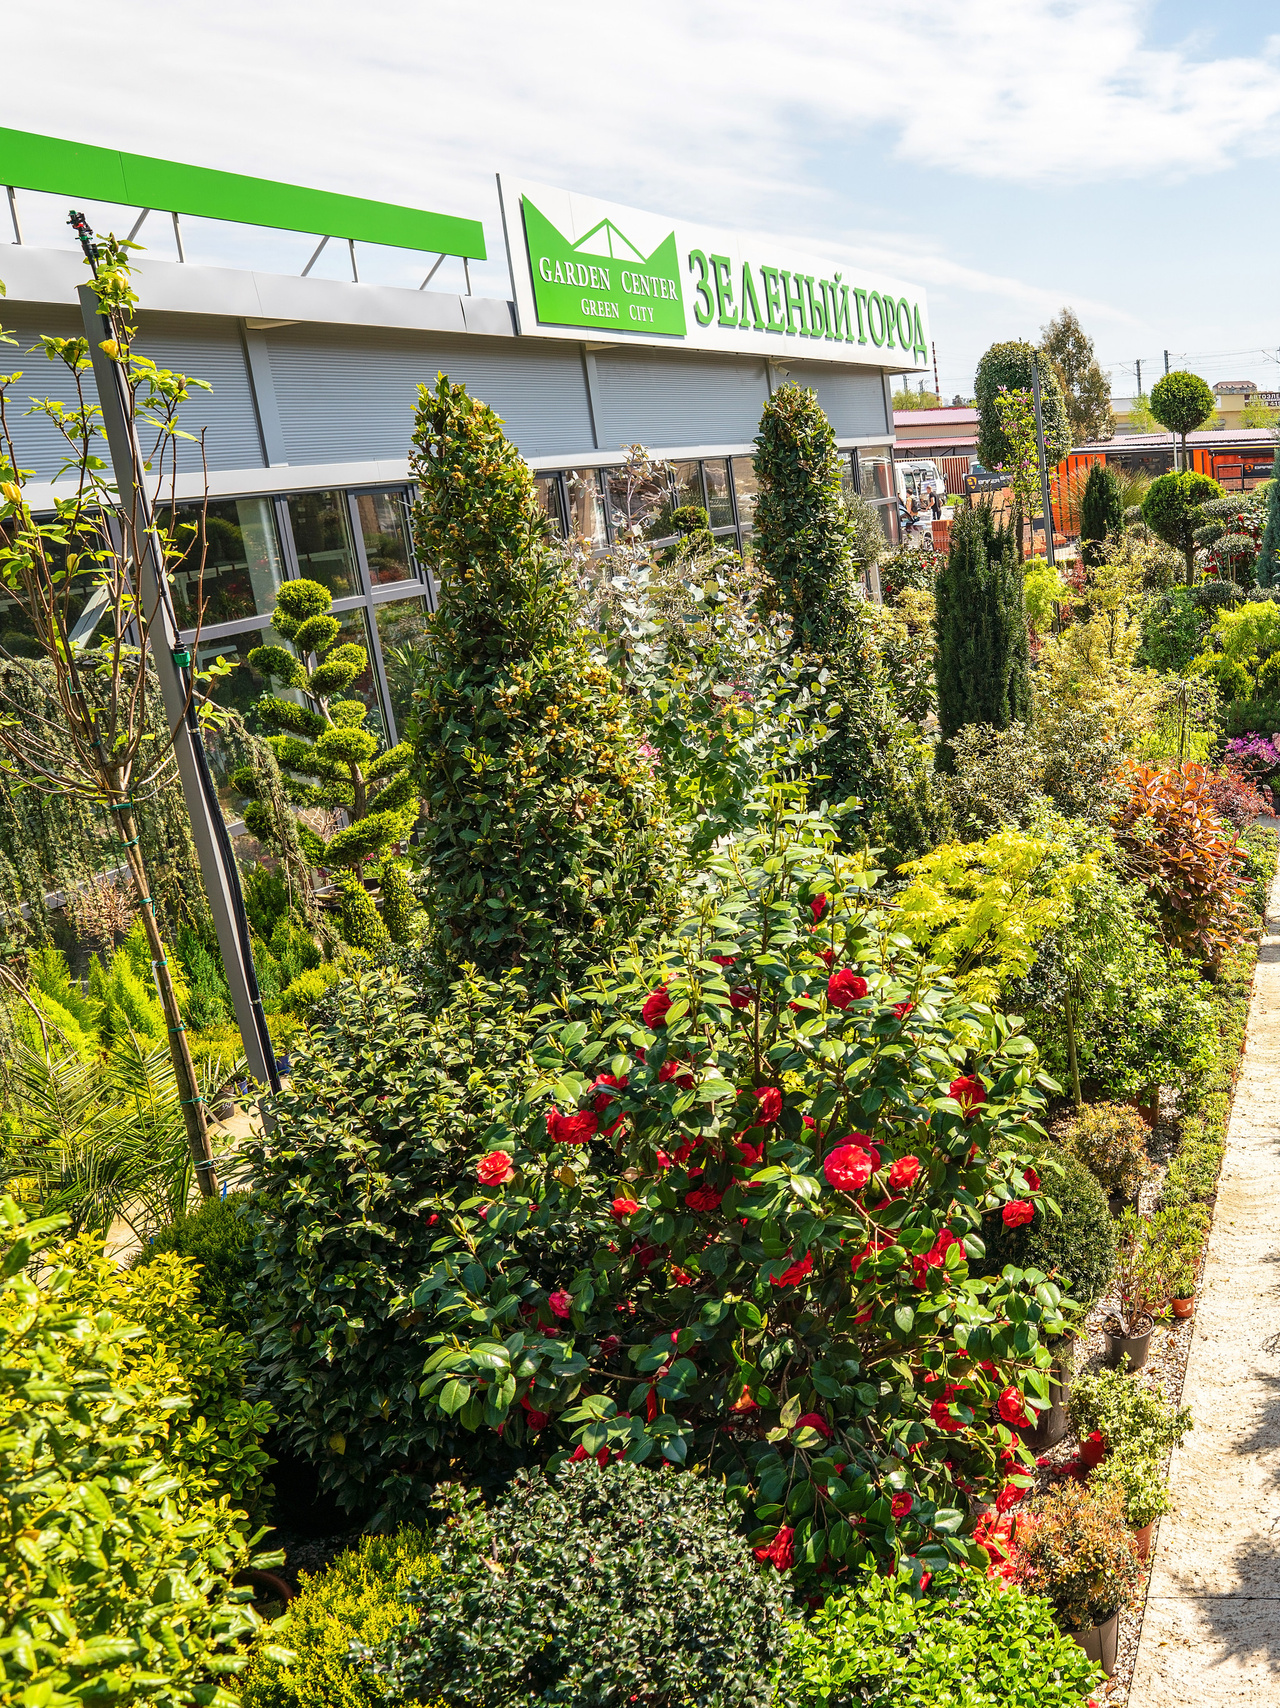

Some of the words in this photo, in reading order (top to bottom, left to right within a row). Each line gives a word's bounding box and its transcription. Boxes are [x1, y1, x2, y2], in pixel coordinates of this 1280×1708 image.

[538, 256, 611, 292] GARDEN
[621, 270, 679, 301] CENTER
[580, 297, 619, 320] GREEN
[629, 304, 654, 324] CITY
[688, 249, 855, 342] ЗЕЛЕНЫЙ
[854, 288, 928, 364] ГОРОД
